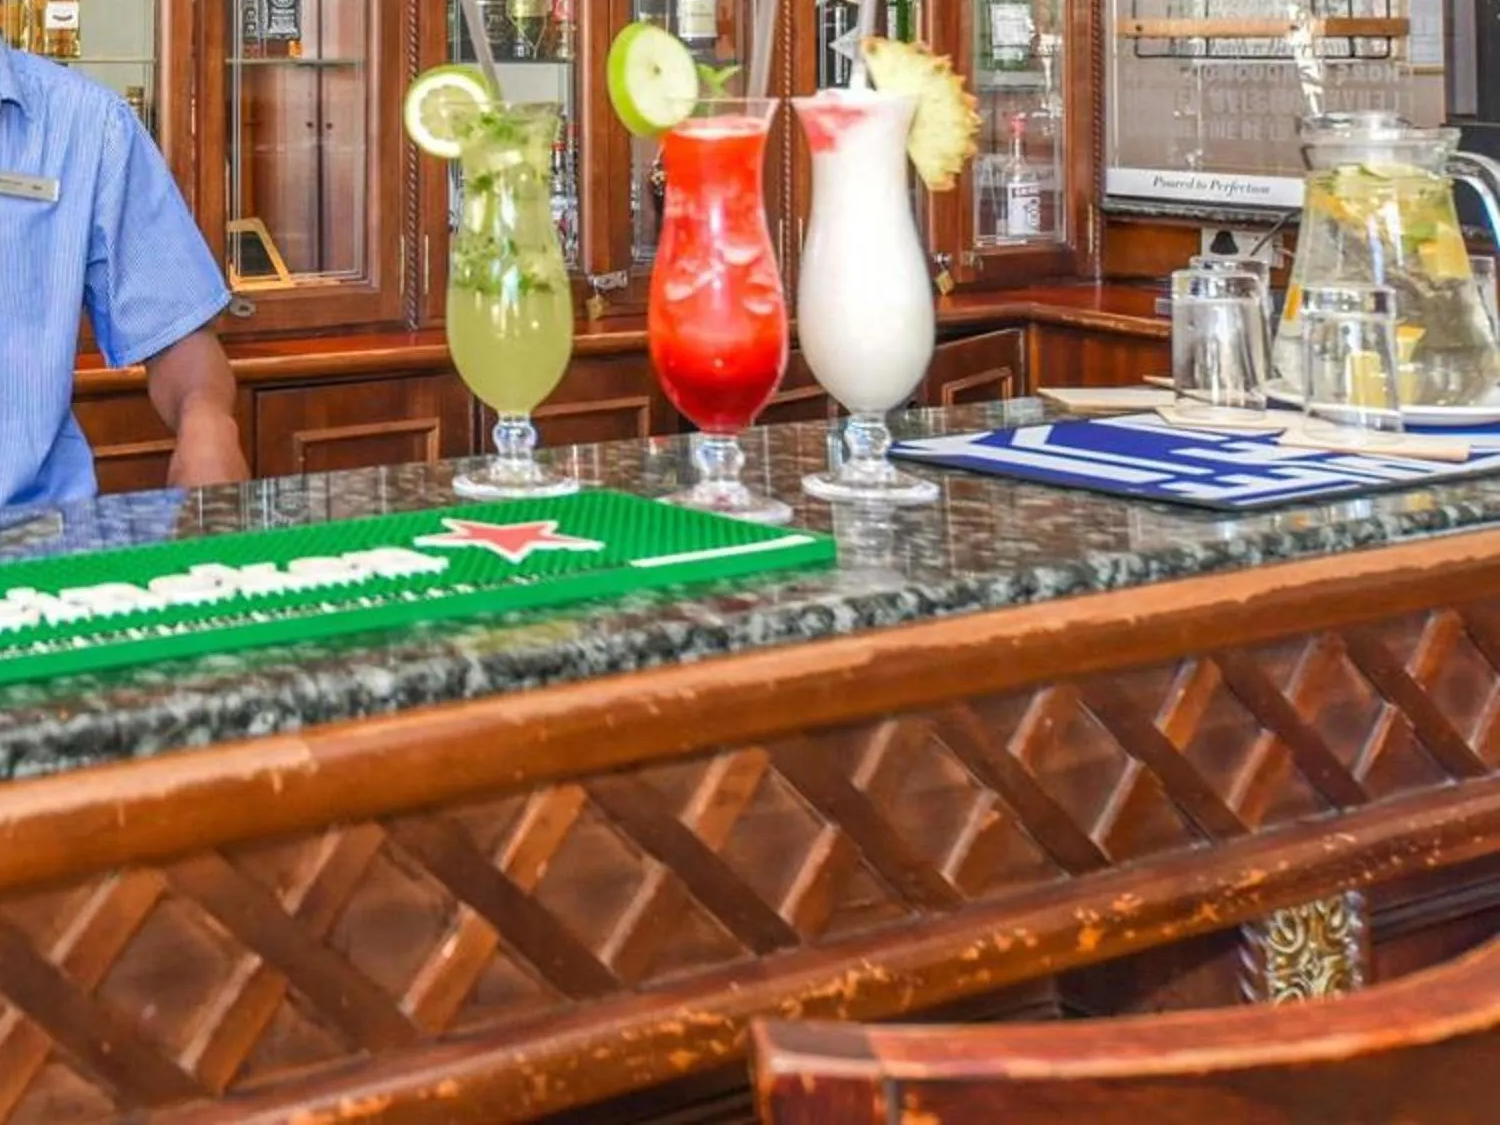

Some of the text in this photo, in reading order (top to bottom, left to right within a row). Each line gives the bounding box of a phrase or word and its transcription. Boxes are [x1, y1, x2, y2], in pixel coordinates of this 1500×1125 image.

[1153, 175, 1271, 196] Poured to Perfection
